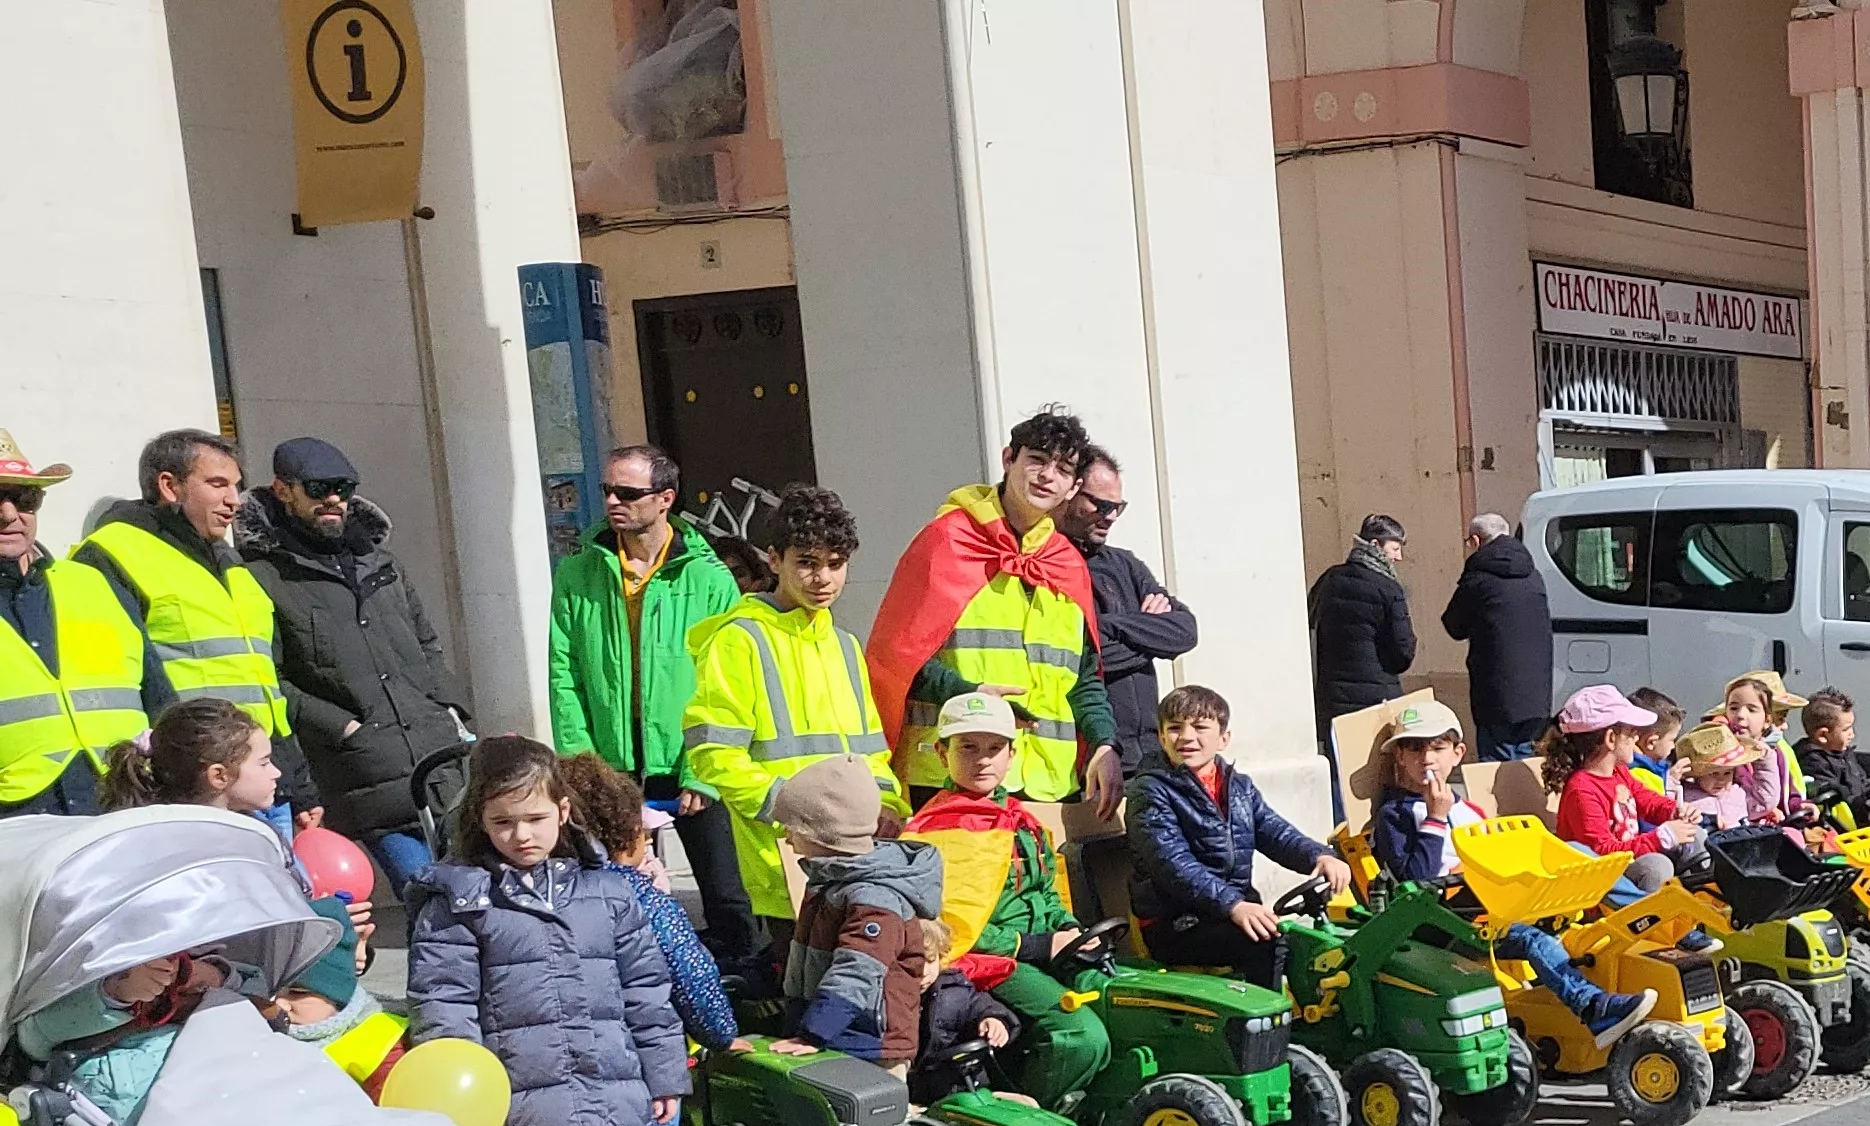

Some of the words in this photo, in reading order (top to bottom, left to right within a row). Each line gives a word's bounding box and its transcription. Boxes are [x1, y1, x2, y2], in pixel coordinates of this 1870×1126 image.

[704, 246, 716, 262] 2
[1544, 270, 1661, 321] CHACINERIA
[1694, 291, 1756, 332] AMADO
[1762, 300, 1796, 337] ARA
